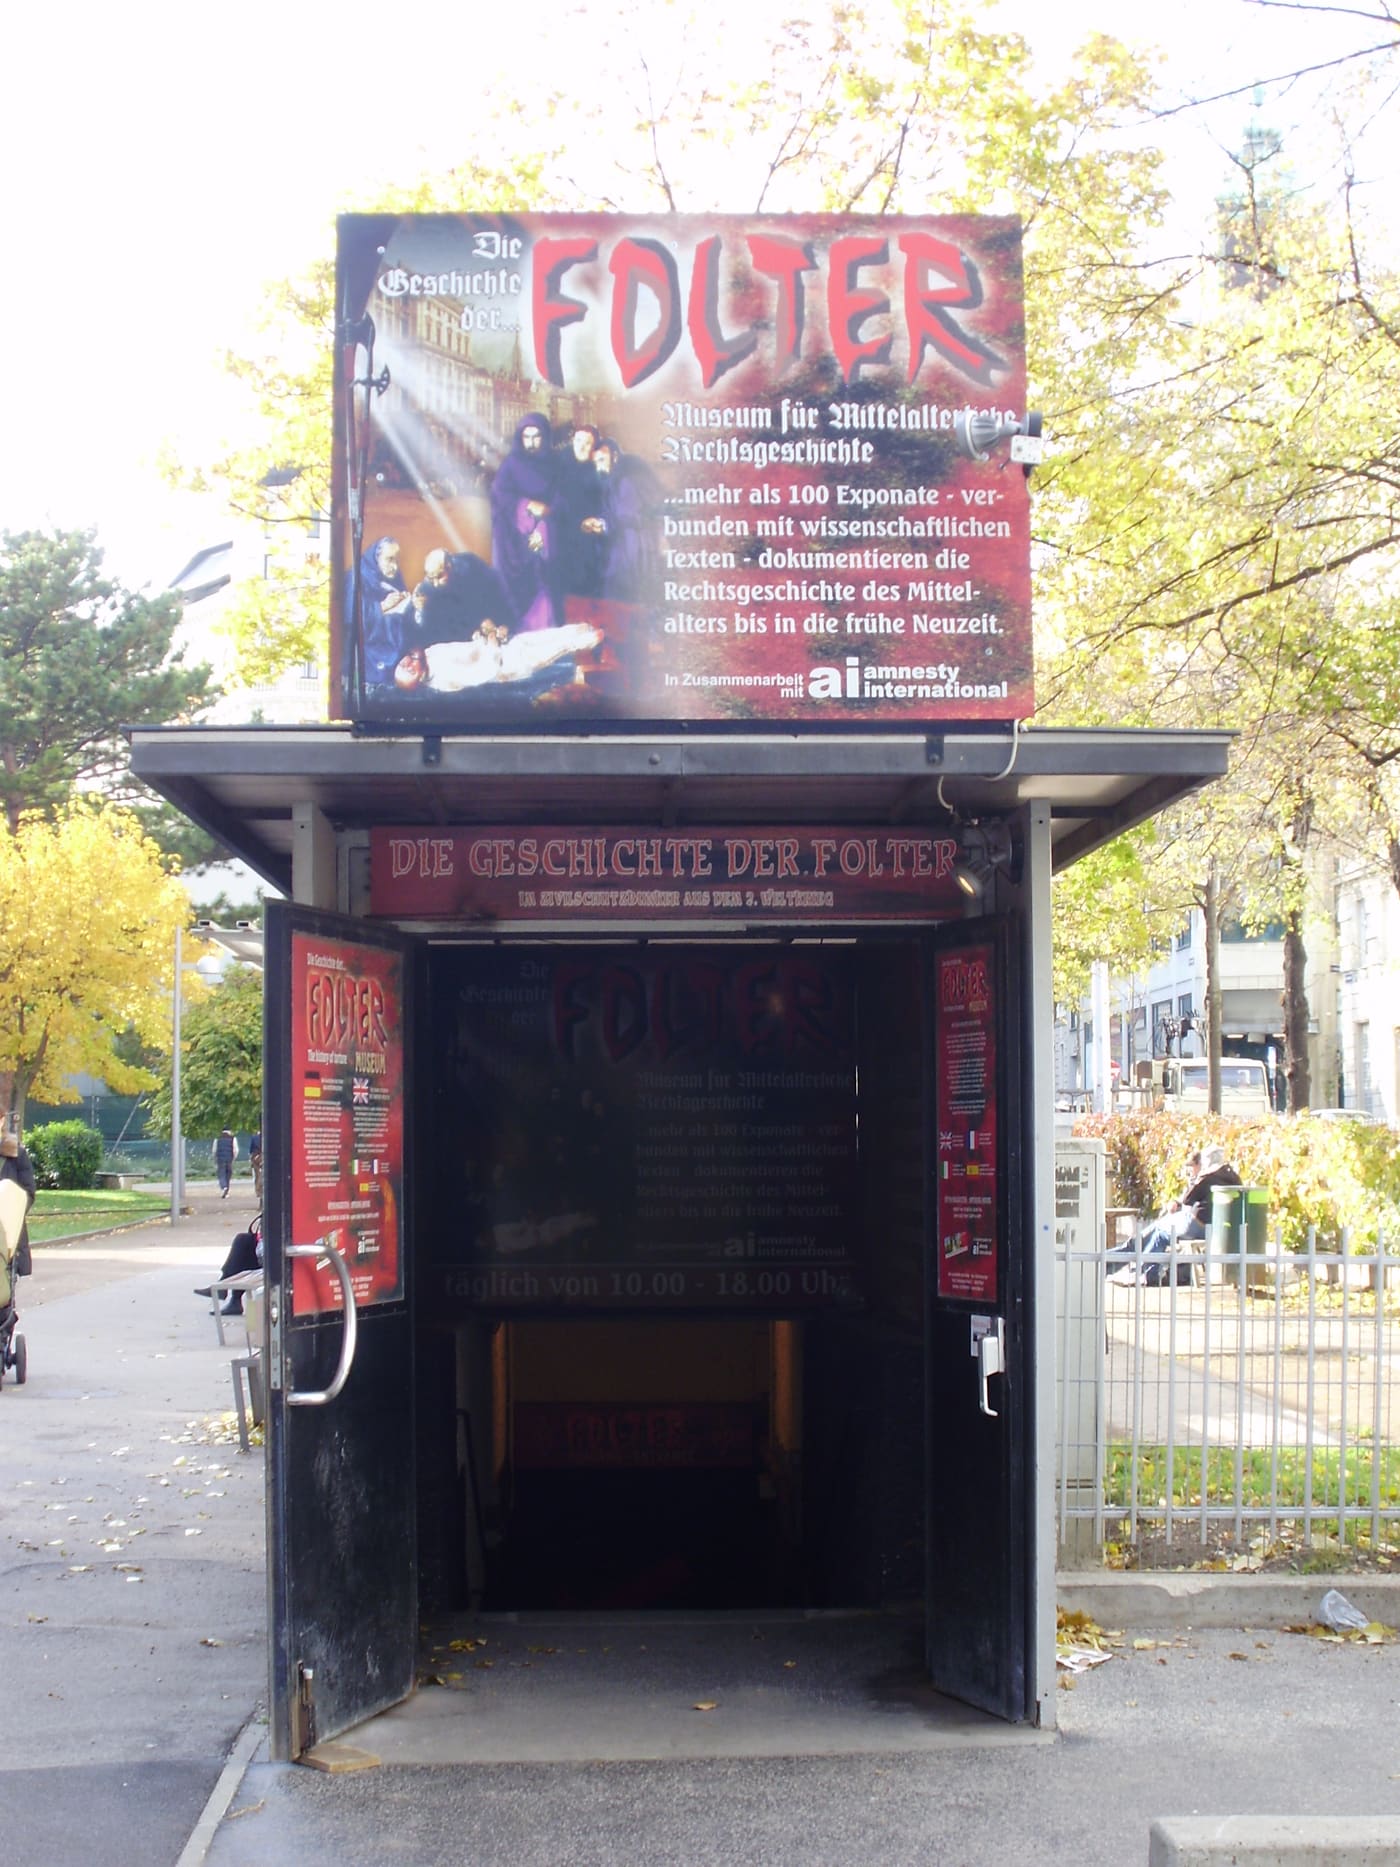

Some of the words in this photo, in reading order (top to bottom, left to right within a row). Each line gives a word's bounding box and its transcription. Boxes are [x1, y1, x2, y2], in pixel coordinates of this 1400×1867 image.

[472, 231, 522, 260] Die
[378, 269, 522, 299] Geschichte
[533, 235, 1009, 390] FOLTER
[661, 403, 772, 430] Museum
[780, 399, 819, 434] für
[661, 437, 874, 468] Rechtsgeschichte
[749, 484, 781, 505] als
[789, 485, 829, 505] 100
[837, 484, 939, 509] Exponate
[961, 488, 1004, 505] ver-
[664, 515, 749, 537] bunden
[757, 515, 794, 537] mit
[800, 515, 1011, 538] wissenschaftlichen
[665, 548, 736, 569] Texten
[758, 548, 928, 570] dokumentieren
[935, 548, 970, 570] die
[664, 581, 856, 606] Rechtsgeschichte
[862, 581, 900, 602] des
[907, 581, 981, 602] Mittel-
[664, 613, 727, 634] alters
[735, 613, 767, 634] bis
[775, 613, 795, 634] in
[803, 613, 838, 634] die
[846, 613, 906, 634] frühe
[913, 613, 1004, 634] Neuzeit.
[665, 673, 679, 686] In
[683, 672, 804, 687] Zusammenarbeit
[808, 656, 860, 699] ai
[864, 664, 960, 681] amnesty
[780, 685, 804, 699] mit
[864, 680, 1008, 699] international
[390, 838, 453, 878] DIE
[469, 838, 712, 878] GESCHICHTE
[725, 838, 800, 878] DER
[811, 838, 957, 878] FOLTER
[307, 969, 389, 1050] FOLTER
[355, 1051, 387, 1075] MUSEUM
[549, 1277, 600, 1297] von
[609, 1272, 686, 1297] 10.00
[716, 1271, 792, 1297] 18.00
